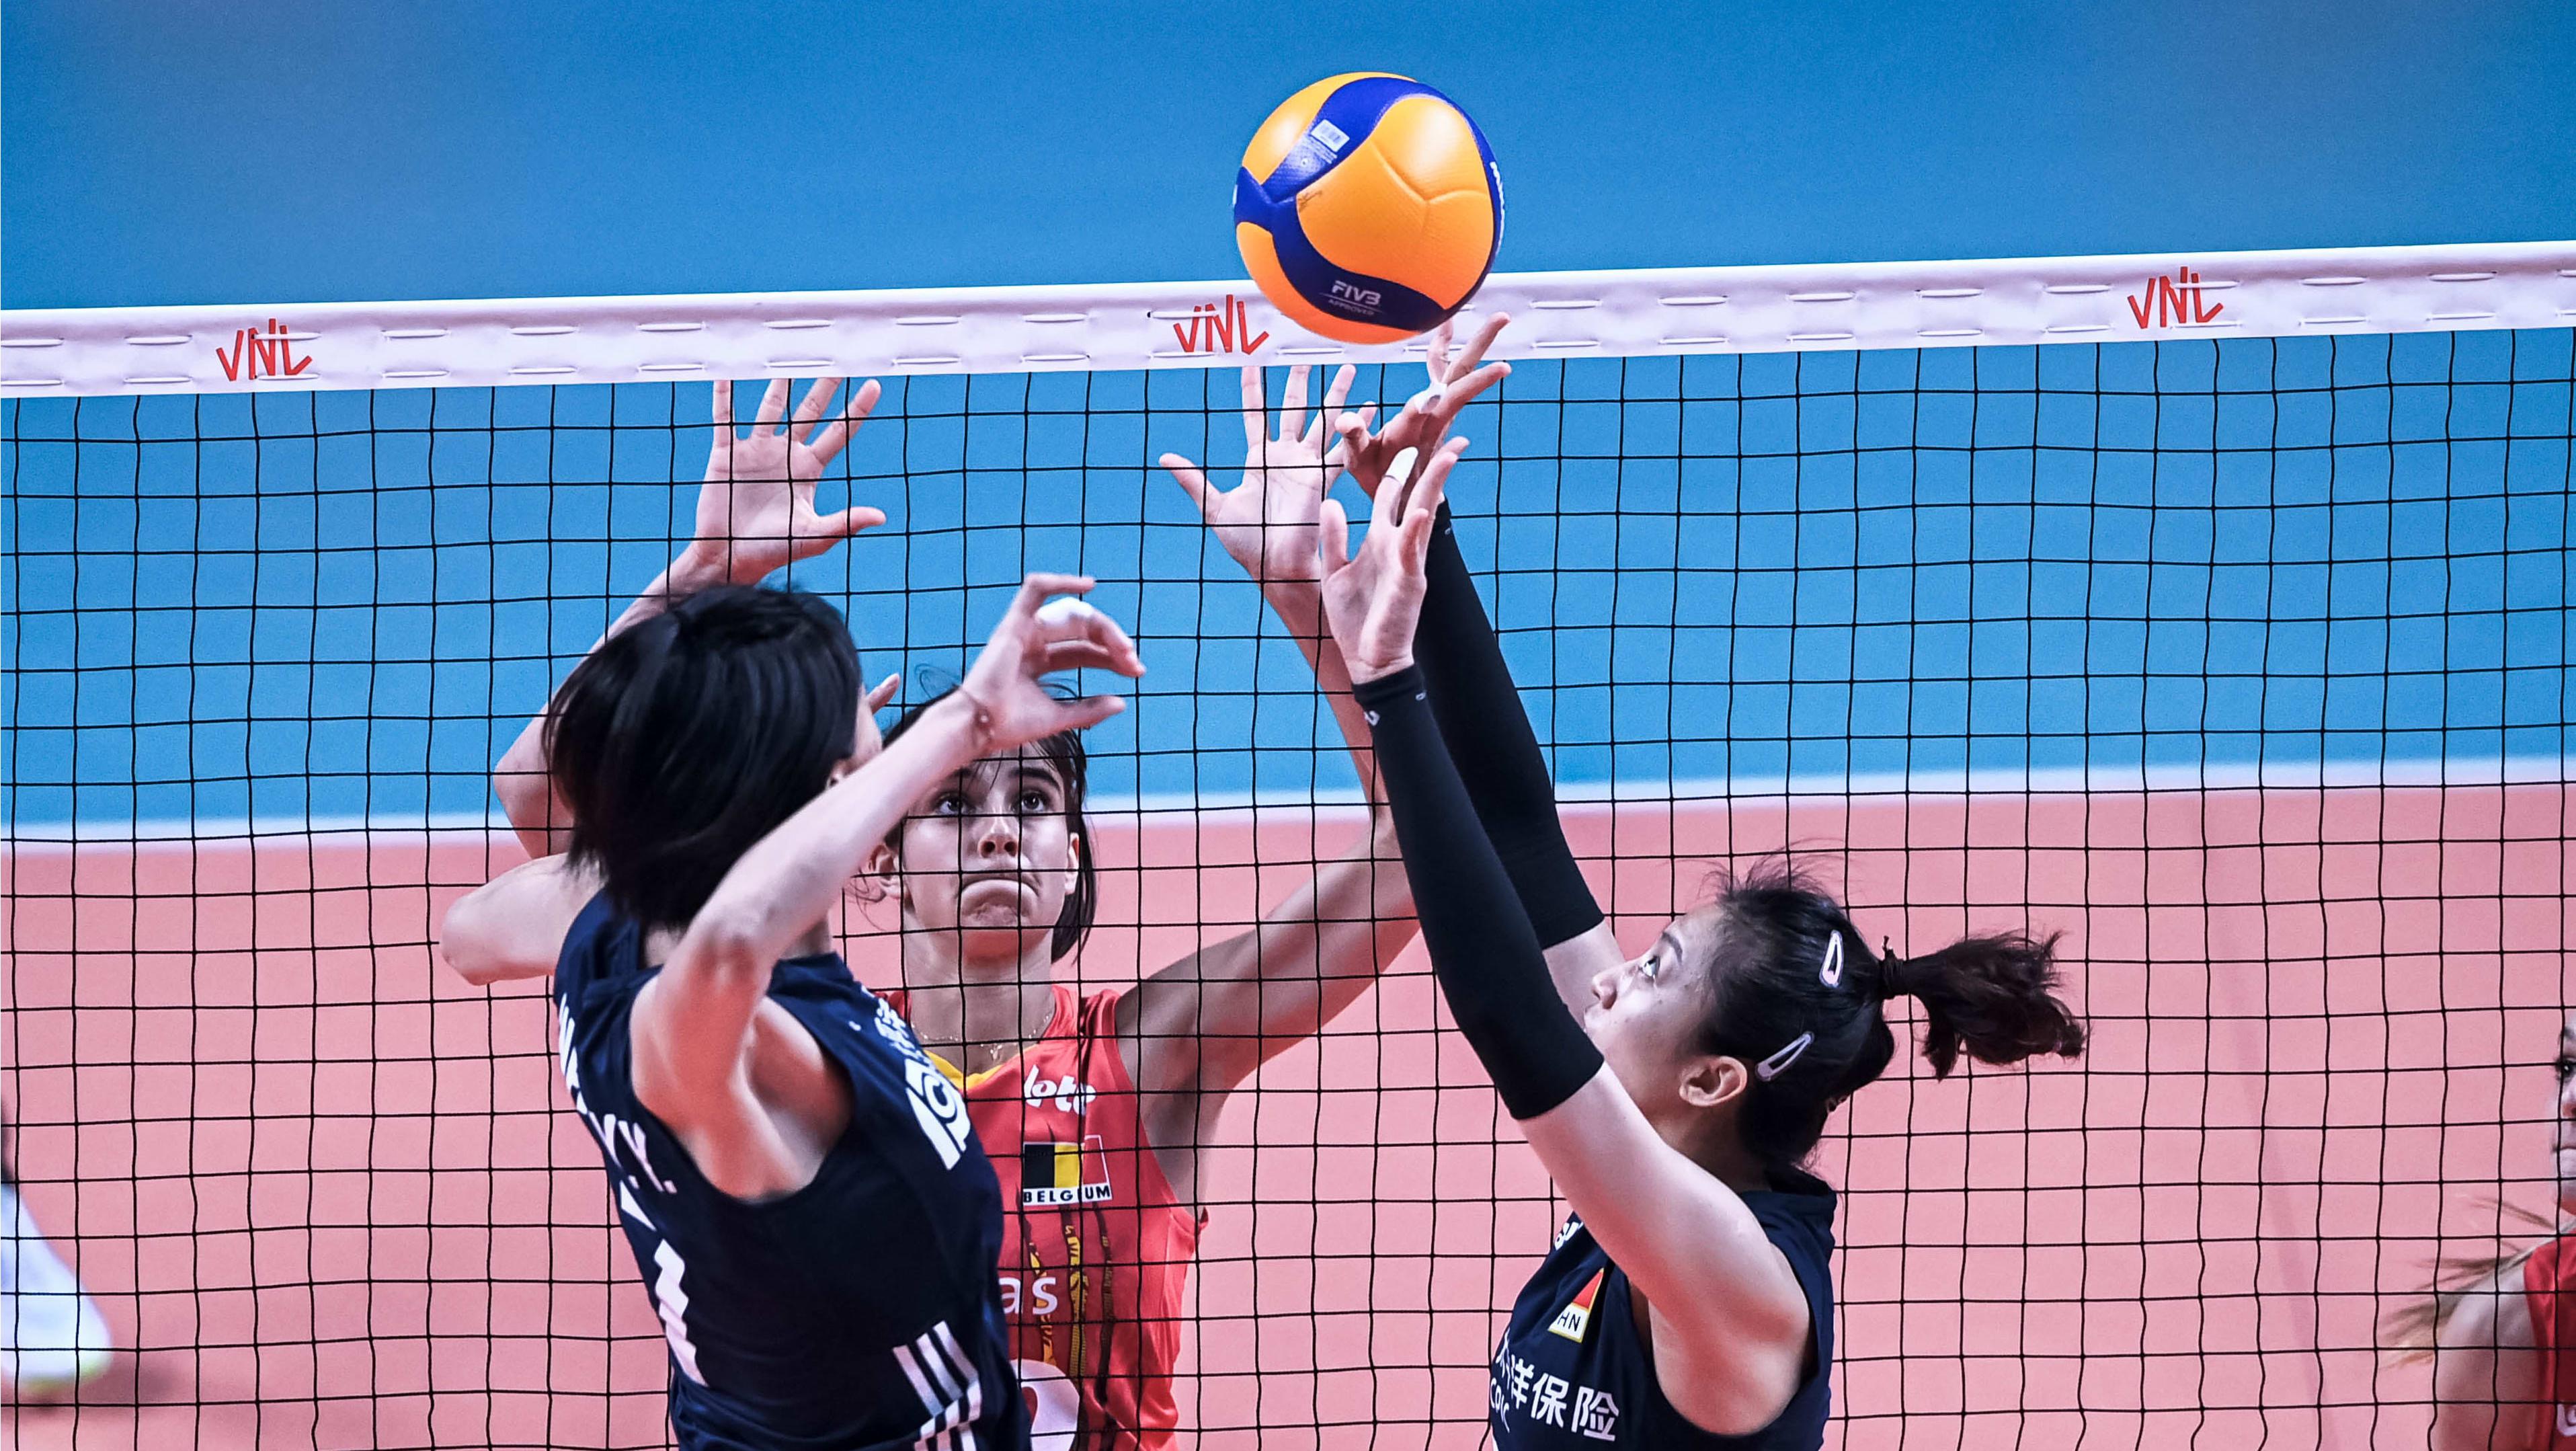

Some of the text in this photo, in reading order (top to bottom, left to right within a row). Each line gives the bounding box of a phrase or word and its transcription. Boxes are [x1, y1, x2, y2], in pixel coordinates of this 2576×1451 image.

[1173, 294, 1269, 355] VNL
[2127, 266, 2224, 329] VNL
[216, 318, 313, 381] VNL
[1022, 1185, 1111, 1204] BELGIUM
[1556, 1312, 1581, 1333] HN
